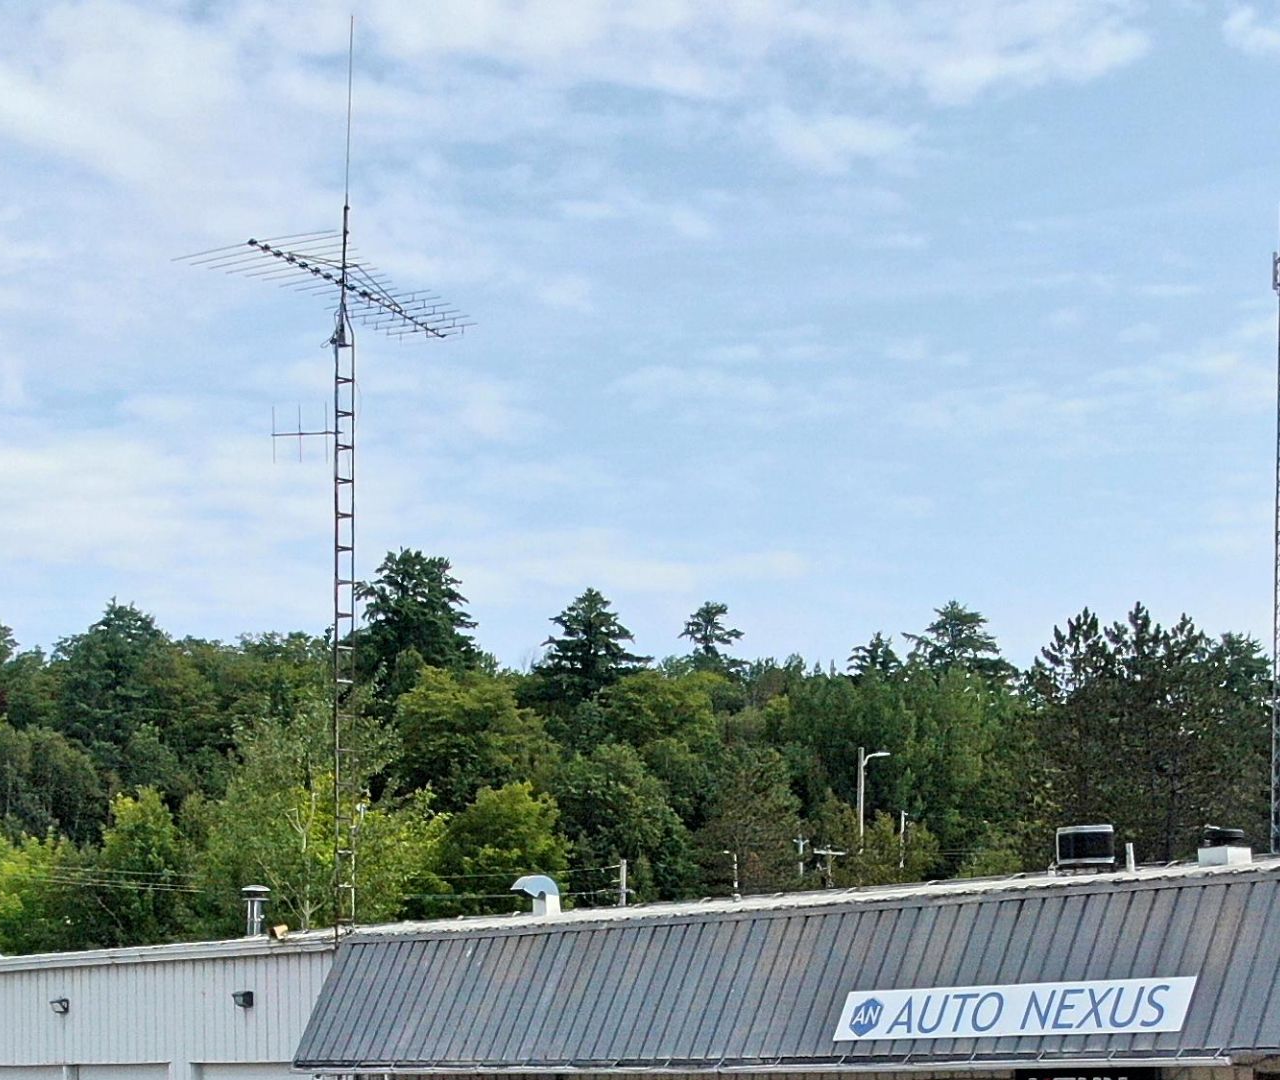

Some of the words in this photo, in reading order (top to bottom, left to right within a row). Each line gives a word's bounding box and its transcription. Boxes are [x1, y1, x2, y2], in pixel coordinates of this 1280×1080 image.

[851, 1005, 878, 1025] AN
[886, 992, 1004, 1035] AUTO
[1020, 984, 1170, 1030] NEXUS
